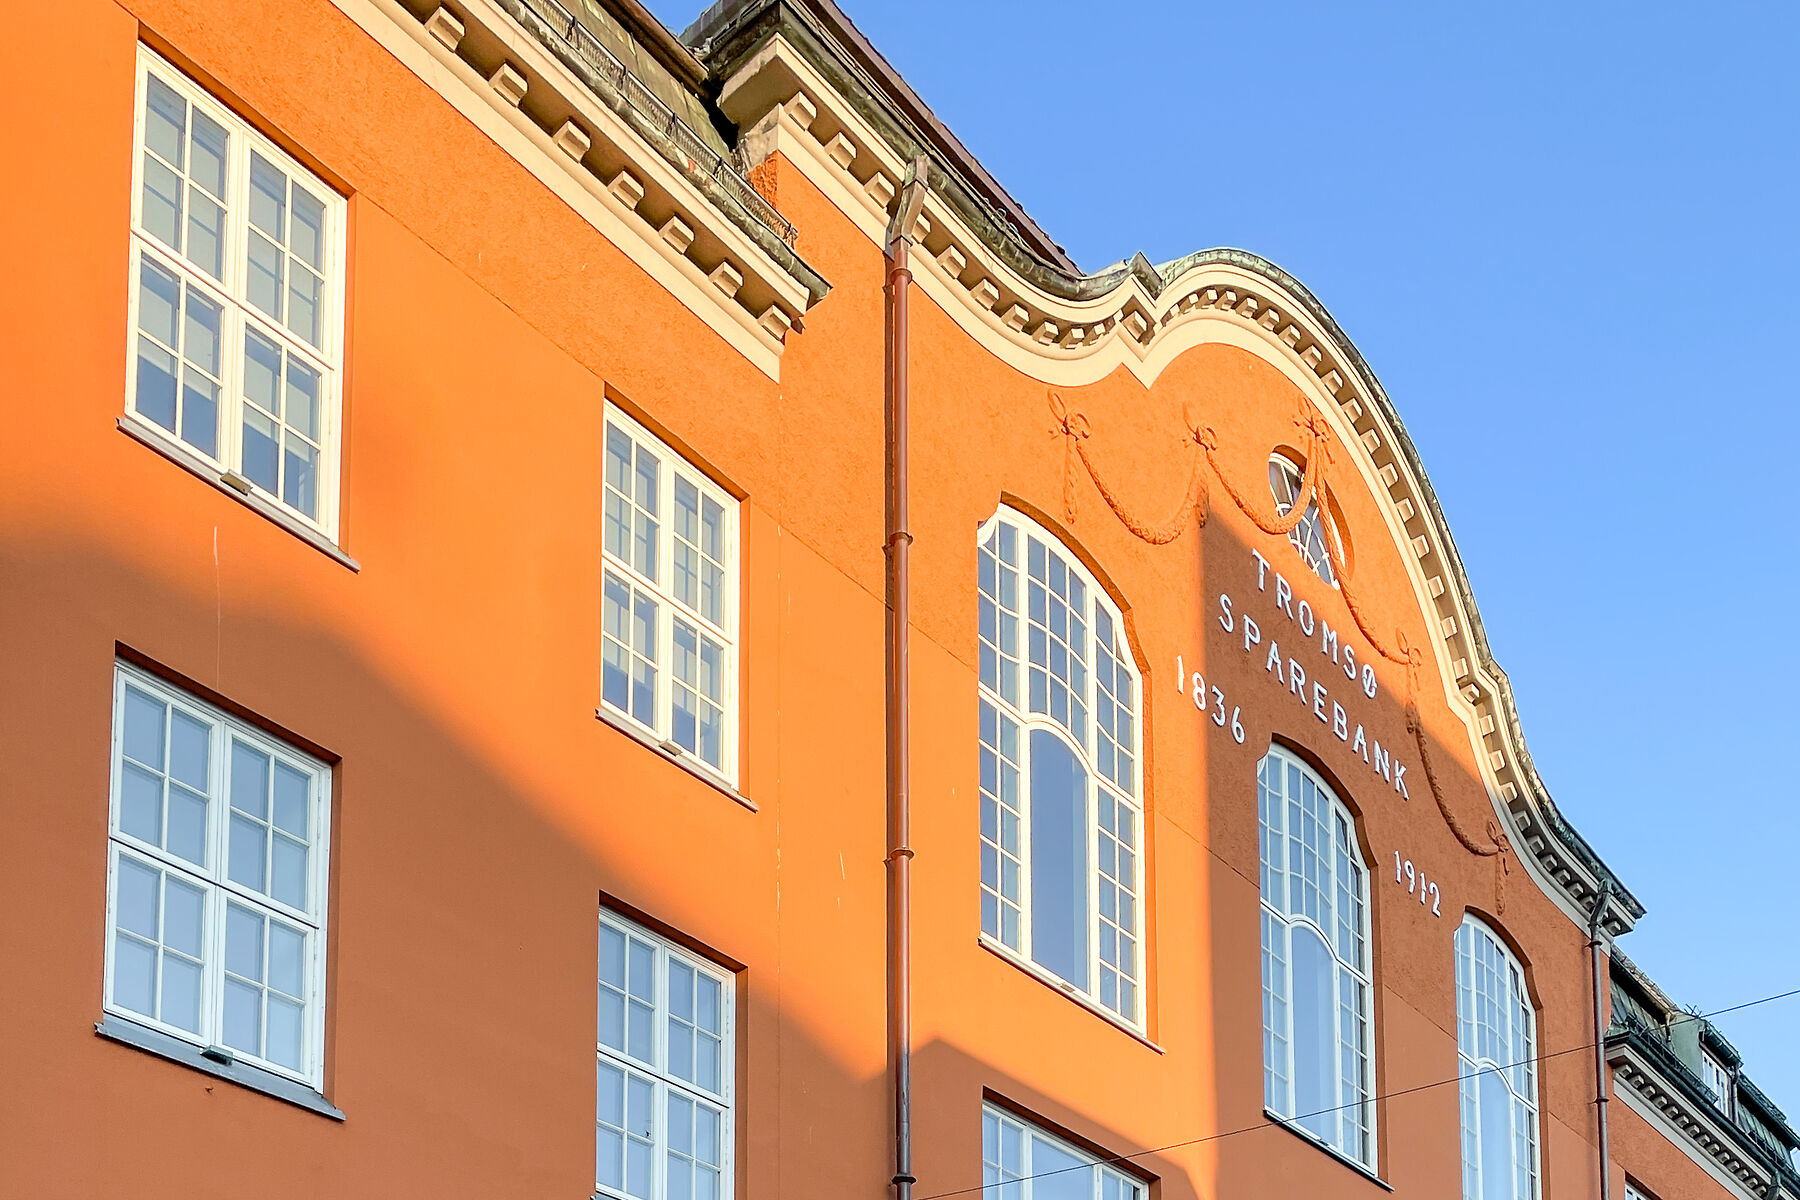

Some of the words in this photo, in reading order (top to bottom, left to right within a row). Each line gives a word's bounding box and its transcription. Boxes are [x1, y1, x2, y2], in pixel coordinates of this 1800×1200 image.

[1252, 548, 1377, 699] TROMSØ
[1176, 655, 1245, 745] 1836
[1218, 593, 1410, 801] SPAREBANK
[1394, 850, 1441, 918] 1912
